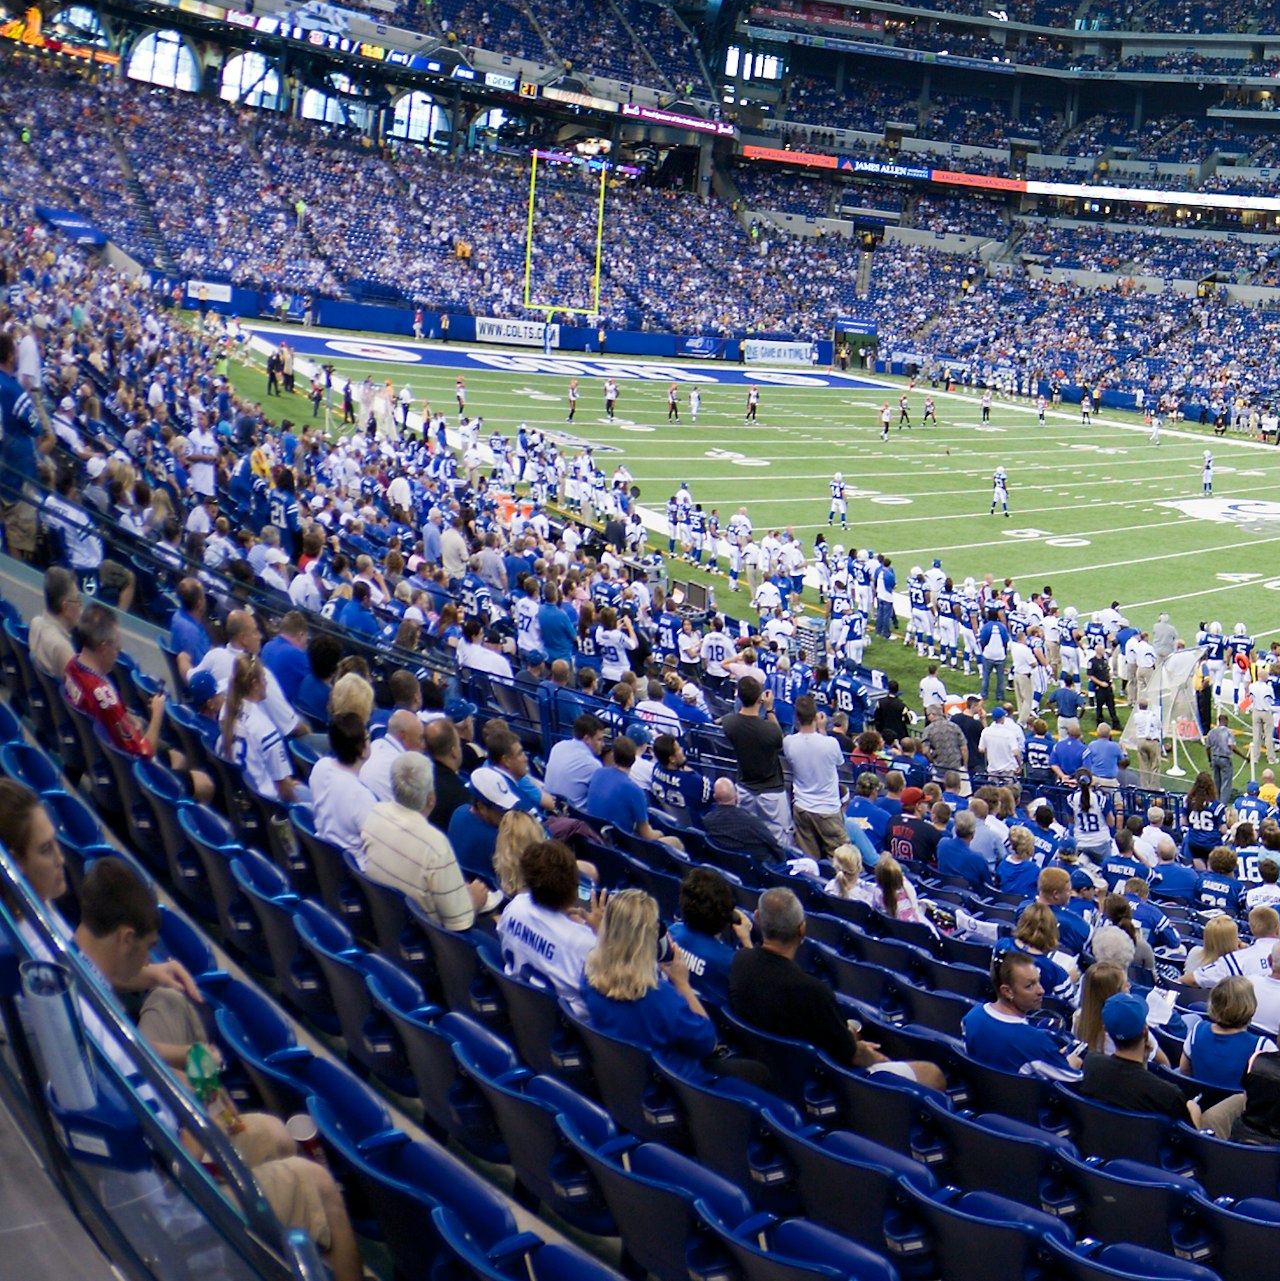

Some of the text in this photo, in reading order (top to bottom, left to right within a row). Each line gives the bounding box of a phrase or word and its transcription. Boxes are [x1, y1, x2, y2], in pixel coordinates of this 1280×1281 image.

[855, 162, 880, 173] JAMES
[881, 164, 907, 176] ALLEN
[659, 628, 675, 649] 31
[708, 644, 725, 661] 18
[835, 688, 854, 712] 18
[1188, 809, 1214, 832] 46
[890, 839, 913, 860] 19
[1237, 856, 1260, 882] 18
[1202, 879, 1230, 893] SANDERS
[507, 916, 555, 961] MANNING
